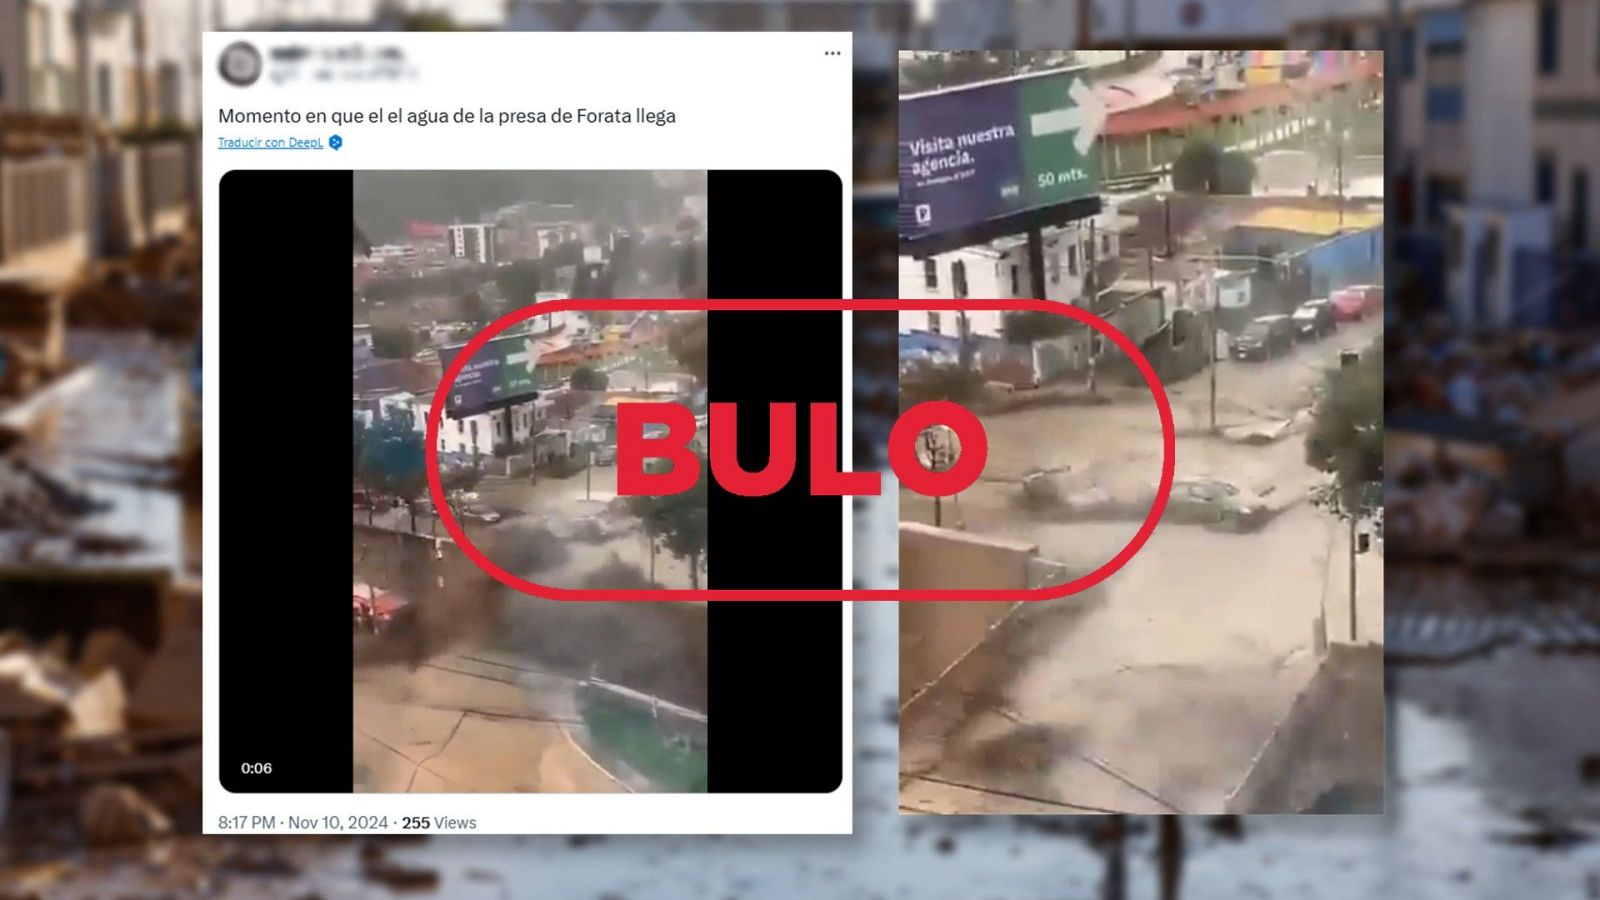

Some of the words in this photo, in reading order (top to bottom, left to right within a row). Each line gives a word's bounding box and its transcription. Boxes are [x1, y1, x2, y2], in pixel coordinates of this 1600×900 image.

[218, 108, 301, 124] Momento
[305, 111, 327, 124] en
[331, 111, 365, 127] que
[368, 107, 383, 124] el
[387, 107, 403, 124] el
[406, 110, 449, 127] agua
[452, 107, 476, 124] de
[479, 107, 495, 124] la
[498, 111, 547, 127] presa
[550, 107, 573, 124] de
[577, 108, 632, 124] Forata
[636, 107, 677, 127] llega
[217, 136, 262, 149] Traducir
[264, 138, 286, 149] con
[289, 136, 324, 149] DeepL
[909, 137, 955, 157] Visita
[957, 124, 1016, 146] nuestra
[911, 150, 976, 177] agencia.
[1037, 172, 1055, 188] 50
[1057, 168, 1089, 184] mts.
[241, 762, 273, 774] 0:06
[217, 815, 249, 830] 8:17
[251, 815, 276, 830] PM
[288, 815, 319, 830] Nov
[322, 815, 344, 832] 10,
[347, 815, 390, 830] 2024
[401, 816, 431, 830] 255
[433, 815, 477, 830] Views
